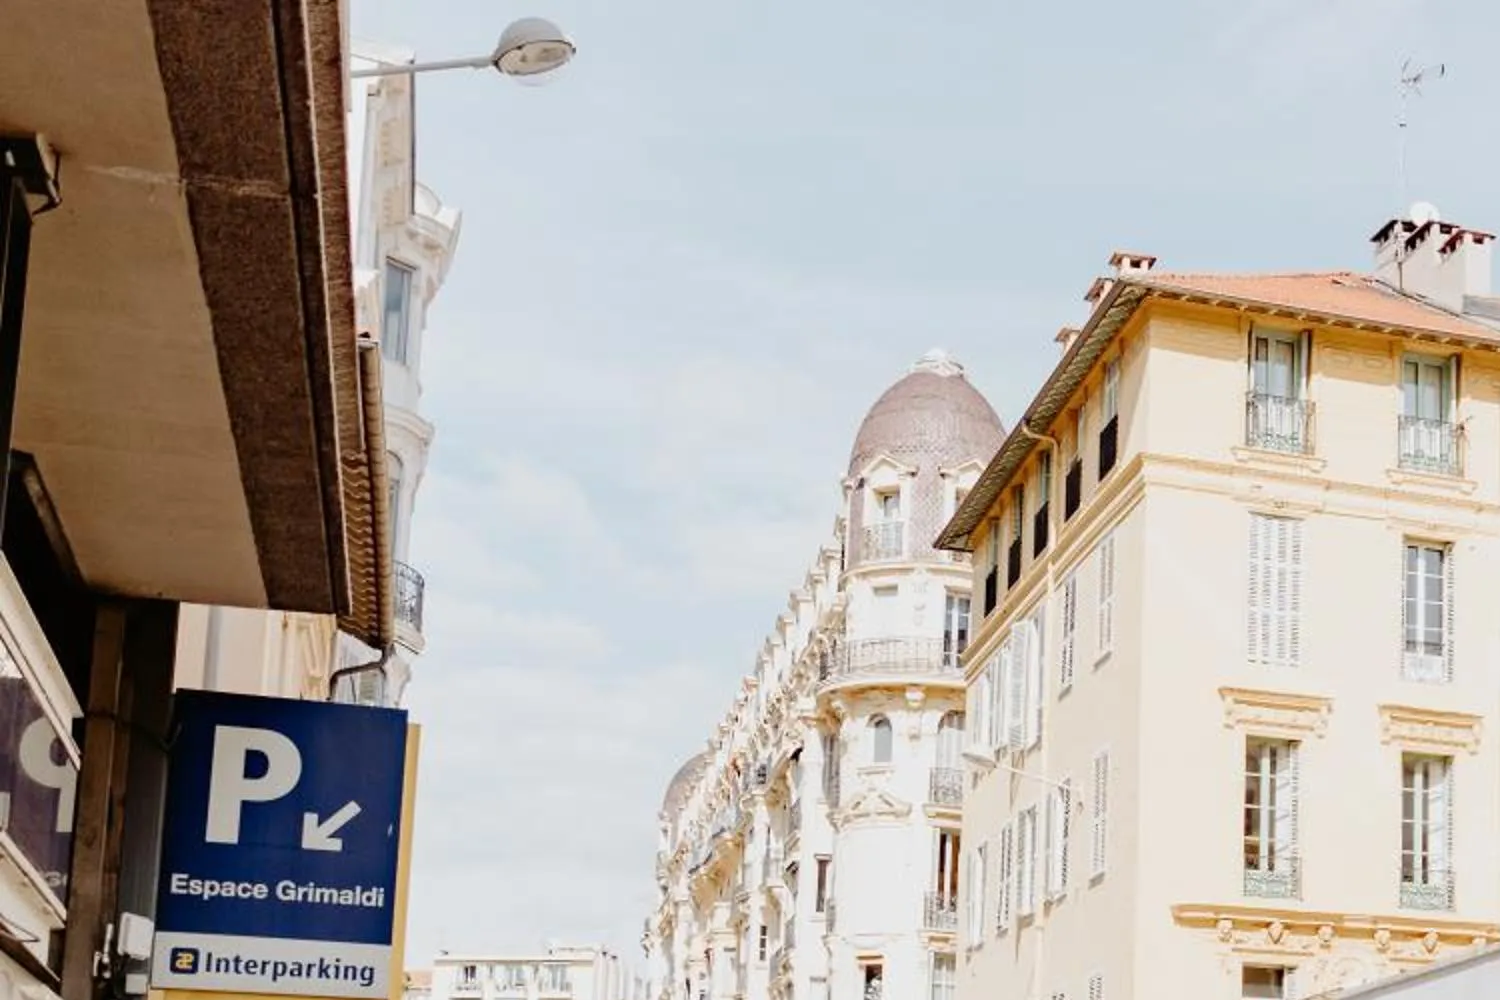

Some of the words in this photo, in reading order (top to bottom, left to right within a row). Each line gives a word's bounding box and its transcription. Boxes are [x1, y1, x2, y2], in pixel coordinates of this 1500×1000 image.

[205, 724, 303, 845] P
[170, 873, 269, 900] Espace
[276, 880, 385, 907] Grimaldi
[205, 952, 376, 986] Interparking
